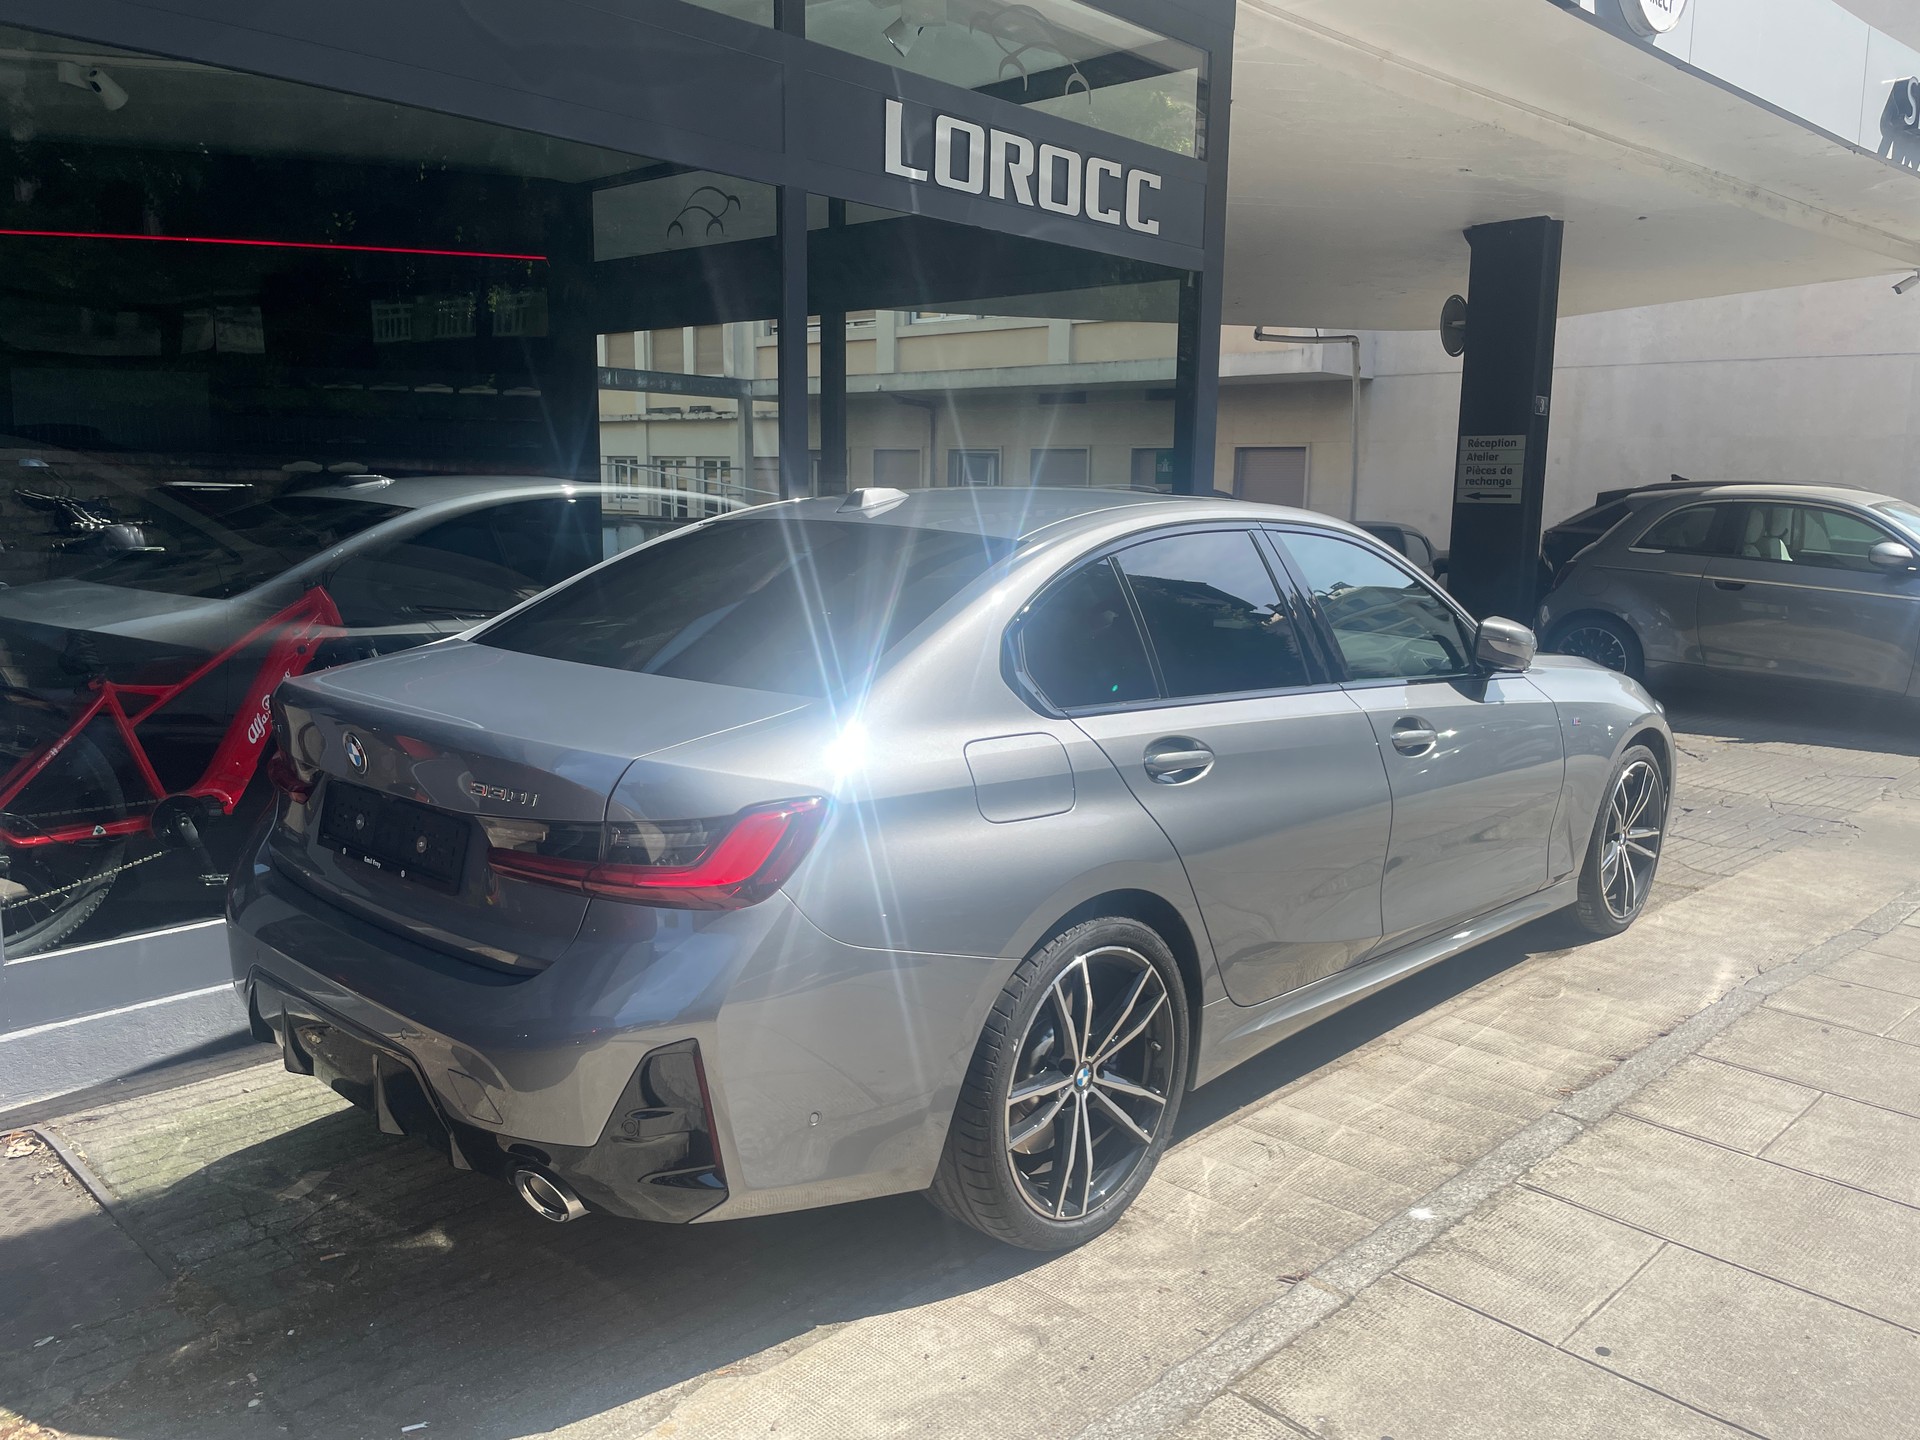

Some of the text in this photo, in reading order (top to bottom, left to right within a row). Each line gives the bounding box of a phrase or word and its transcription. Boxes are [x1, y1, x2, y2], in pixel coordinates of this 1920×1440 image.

[884, 98, 1162, 236] LOROCC
[1467, 438, 1517, 449] Réception
[1466, 452, 1499, 461] Atelier
[1466, 465, 1513, 475] Pièces de
[1465, 477, 1512, 487] rechange
[248, 712, 270, 745] Alfa
